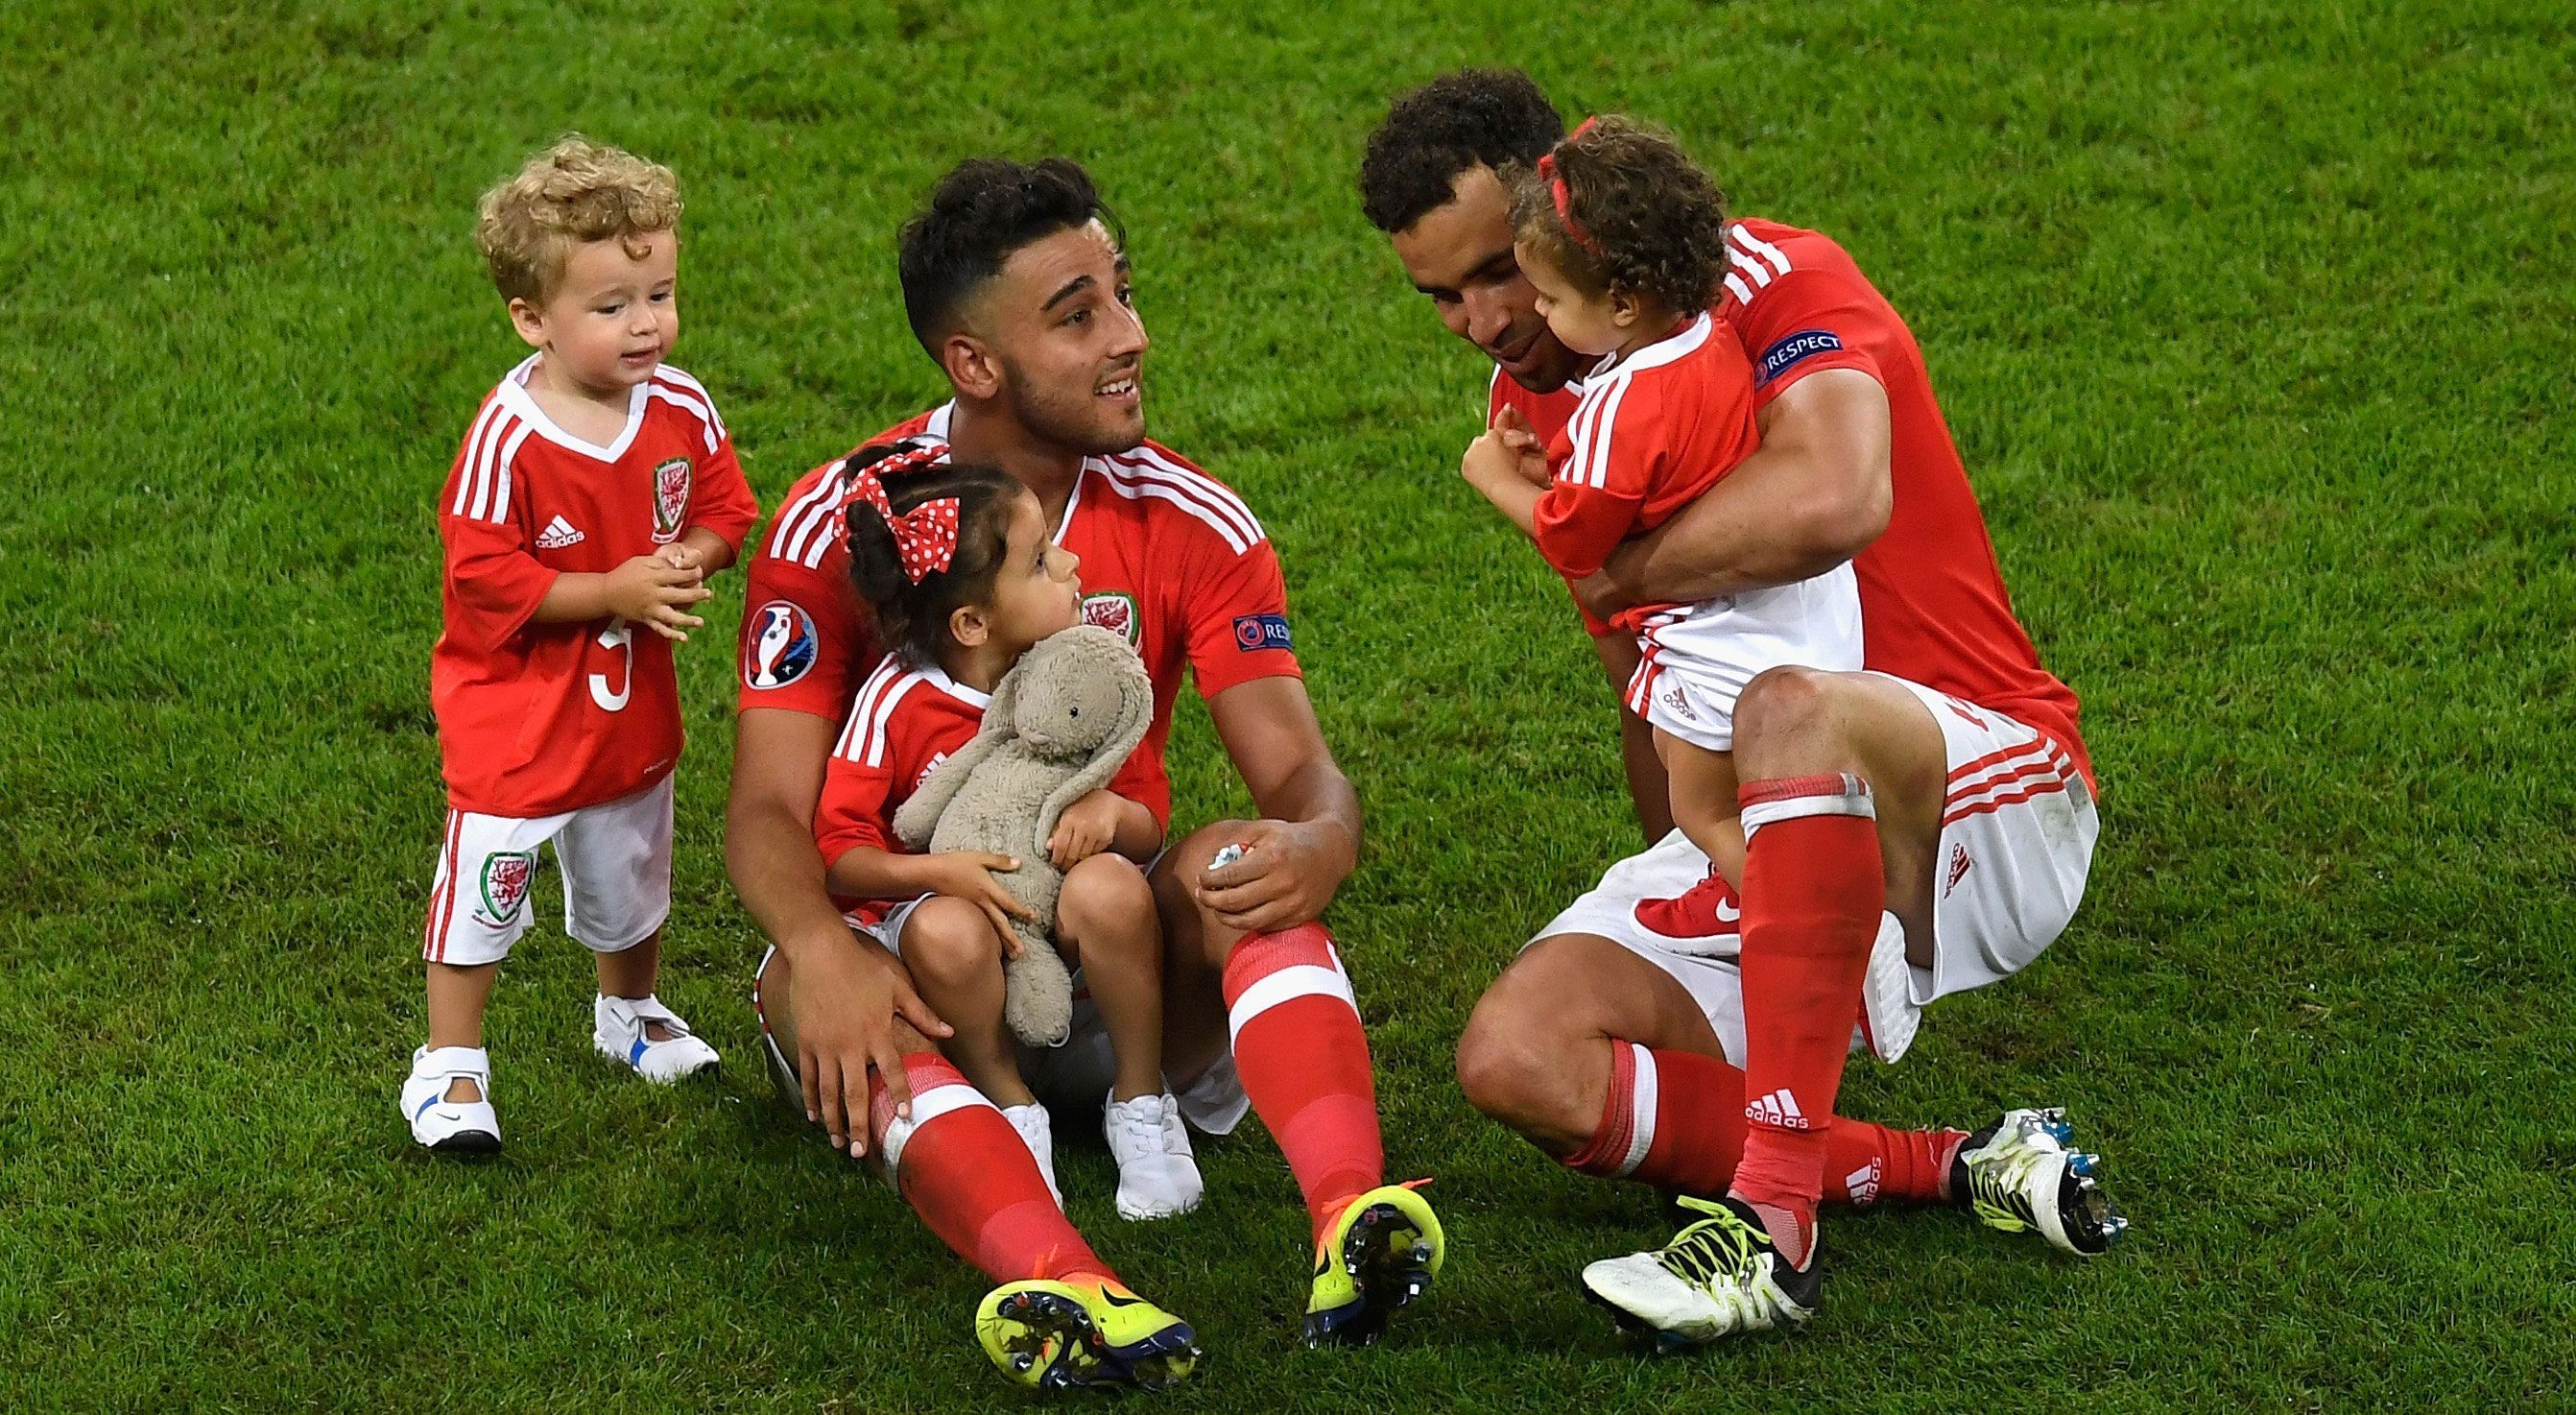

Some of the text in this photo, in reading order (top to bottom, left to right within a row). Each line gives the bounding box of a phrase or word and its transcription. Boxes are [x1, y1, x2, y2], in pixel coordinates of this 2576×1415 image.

[1767, 336, 1839, 371] RESPECT
[536, 531, 584, 548] adidas
[1745, 1107, 1808, 1128] adidas
